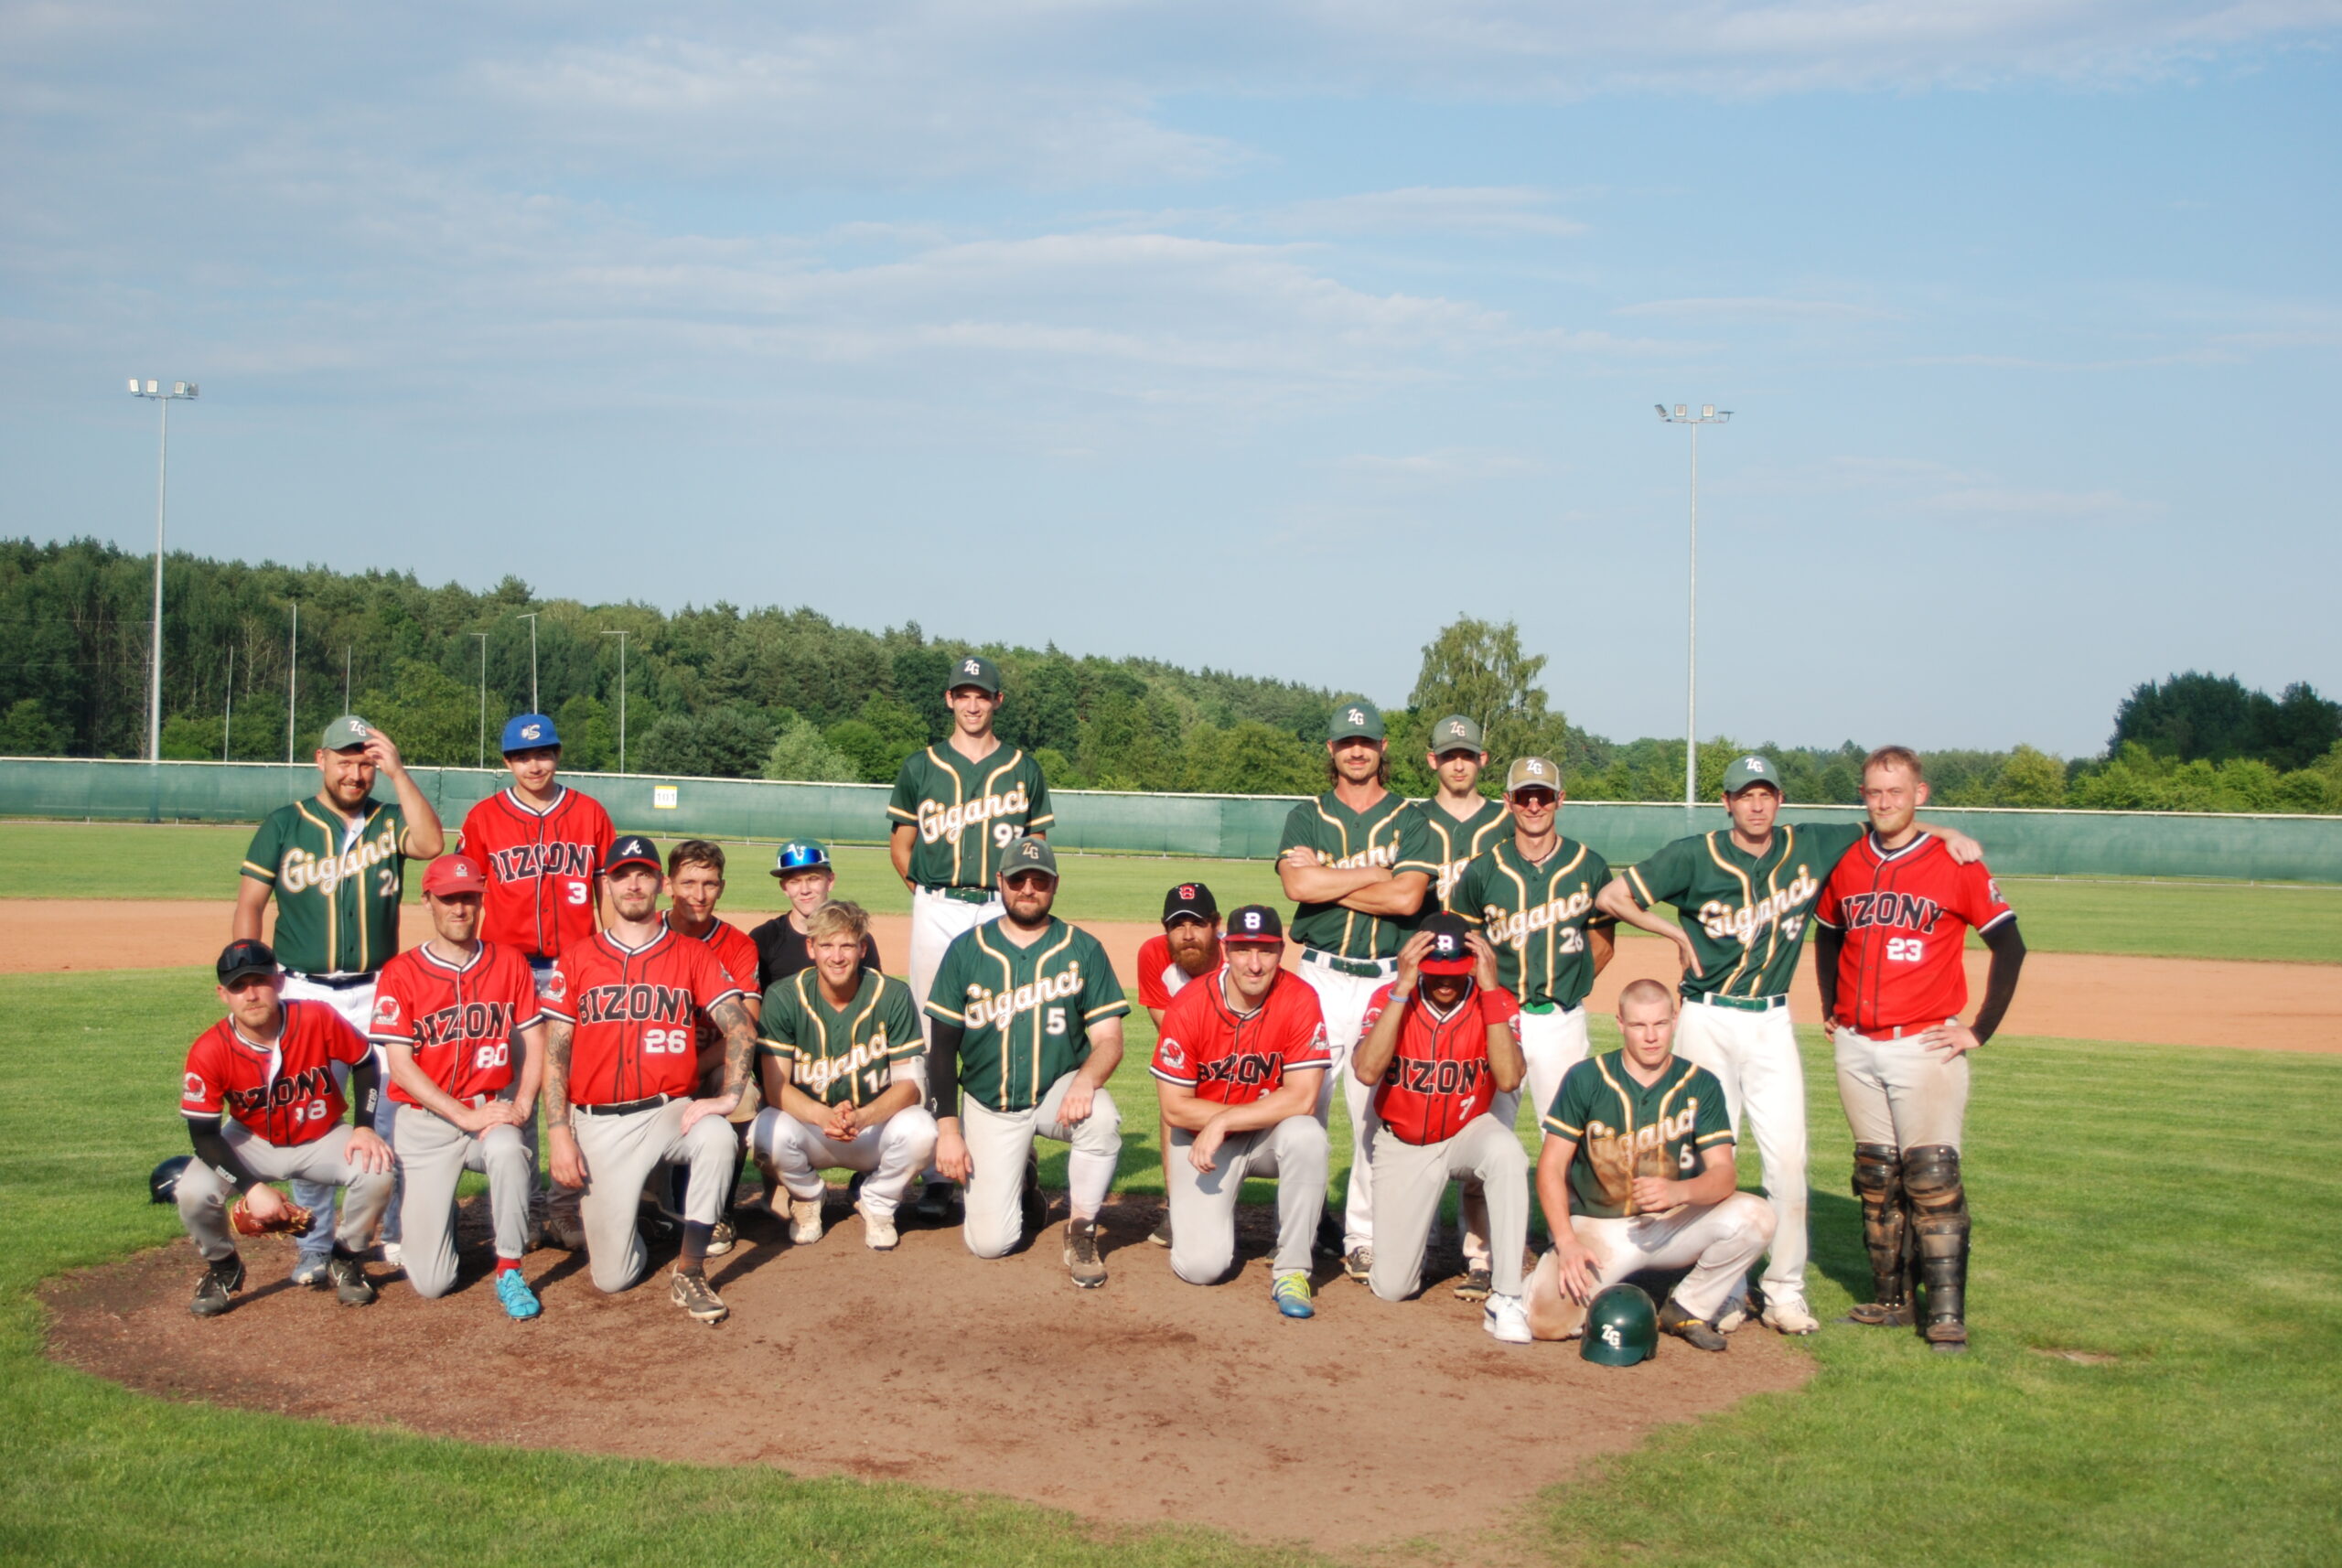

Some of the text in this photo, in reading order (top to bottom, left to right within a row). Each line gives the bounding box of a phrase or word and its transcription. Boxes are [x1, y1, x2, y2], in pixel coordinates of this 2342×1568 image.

[1348, 708, 1364, 725] ZG
[1449, 721, 1466, 737] ZG
[1527, 759, 1542, 775] ZG
[1746, 757, 1763, 773] ZG
[918, 781, 1028, 844] Giganci
[283, 818, 397, 896] Giganci
[622, 840, 641, 855] A
[1022, 843, 1039, 859] ZG
[568, 882, 587, 904] 3
[1698, 864, 1818, 944] Giganci
[1244, 912, 1260, 929] B
[1484, 882, 1592, 950] Giganci
[1842, 891, 1947, 934] IZONY
[1437, 934, 1453, 950] B
[1885, 937, 1923, 962] 23
[965, 961, 1083, 1031] Giganci
[1046, 1007, 1066, 1035] 5
[645, 1029, 686, 1053] 26
[477, 1043, 509, 1069] 80
[295, 1100, 327, 1125] 18
[1586, 1097, 1698, 1172] Giganci
[1602, 1324, 1620, 1347] ZG
